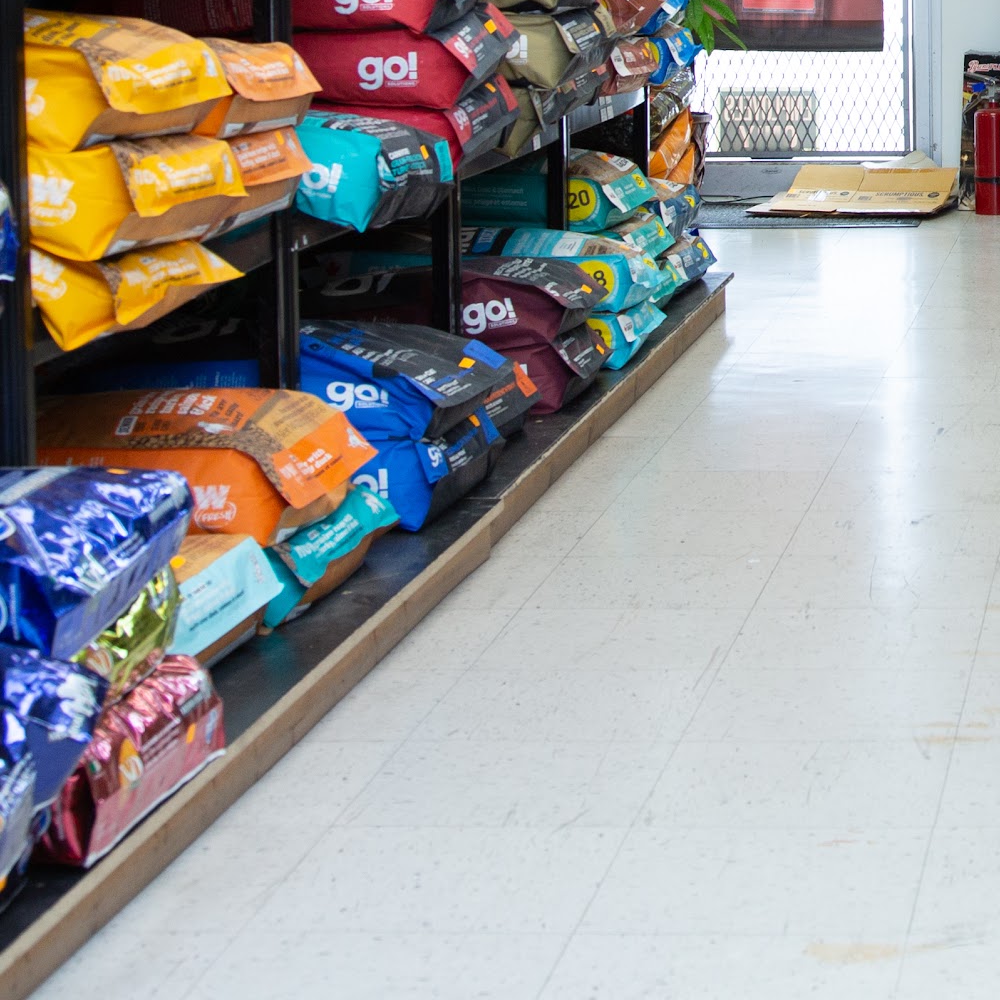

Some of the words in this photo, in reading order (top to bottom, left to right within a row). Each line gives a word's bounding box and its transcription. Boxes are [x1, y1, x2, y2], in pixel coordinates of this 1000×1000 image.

[357, 51, 418, 91] go!
[303, 163, 343, 193] o!
[567, 190, 590, 208] 20
[463, 298, 517, 335] go!
[326, 381, 389, 412] go!
[352, 468, 389, 499] o!
